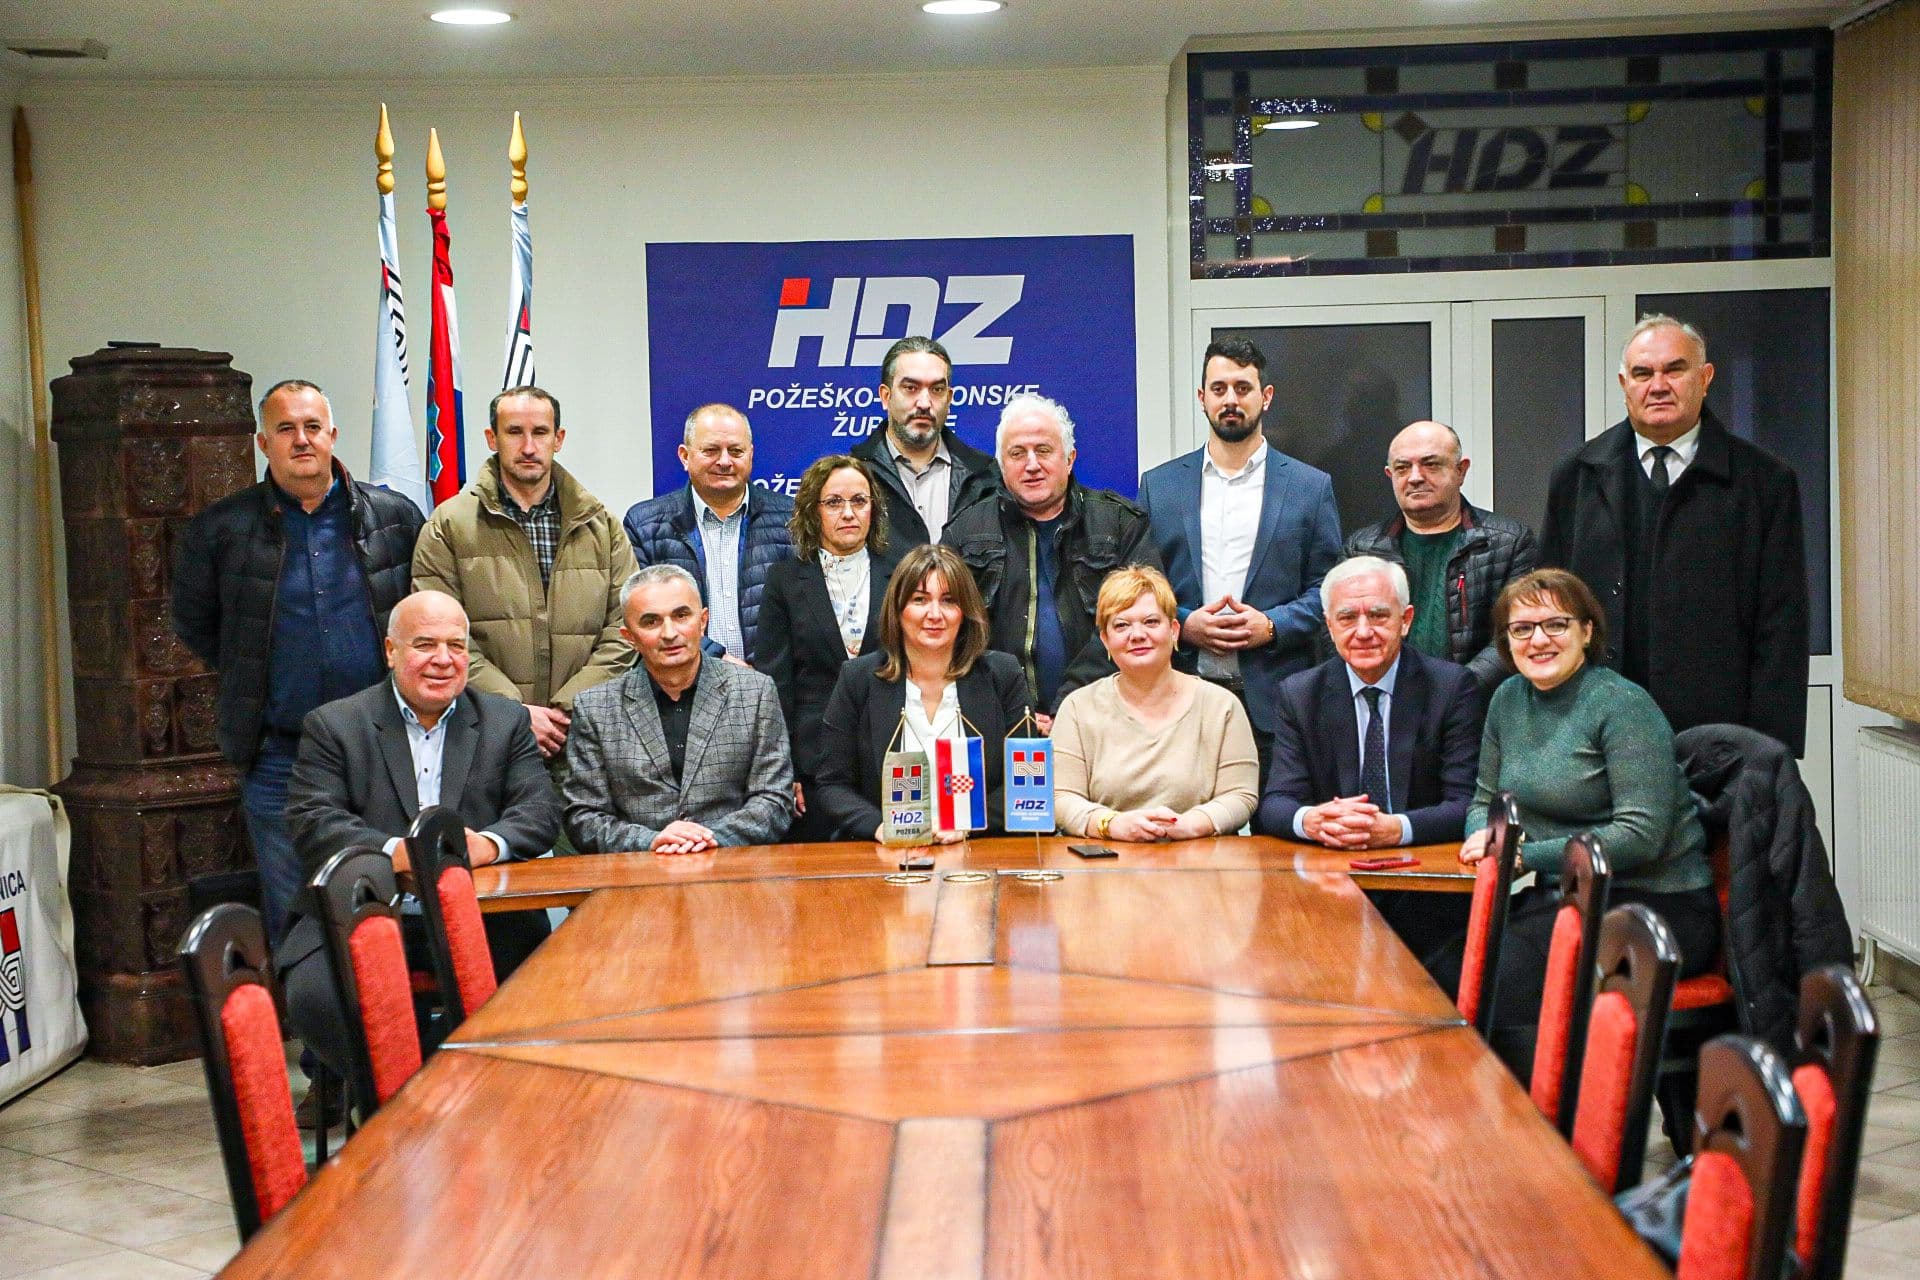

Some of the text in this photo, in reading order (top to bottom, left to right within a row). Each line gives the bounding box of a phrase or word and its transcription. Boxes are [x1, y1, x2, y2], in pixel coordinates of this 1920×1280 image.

[1395, 112, 1614, 194] HDZ
[767, 274, 1025, 368] HDZ
[891, 810, 923, 825] HDZ
[1014, 799, 1046, 810] HDZ
